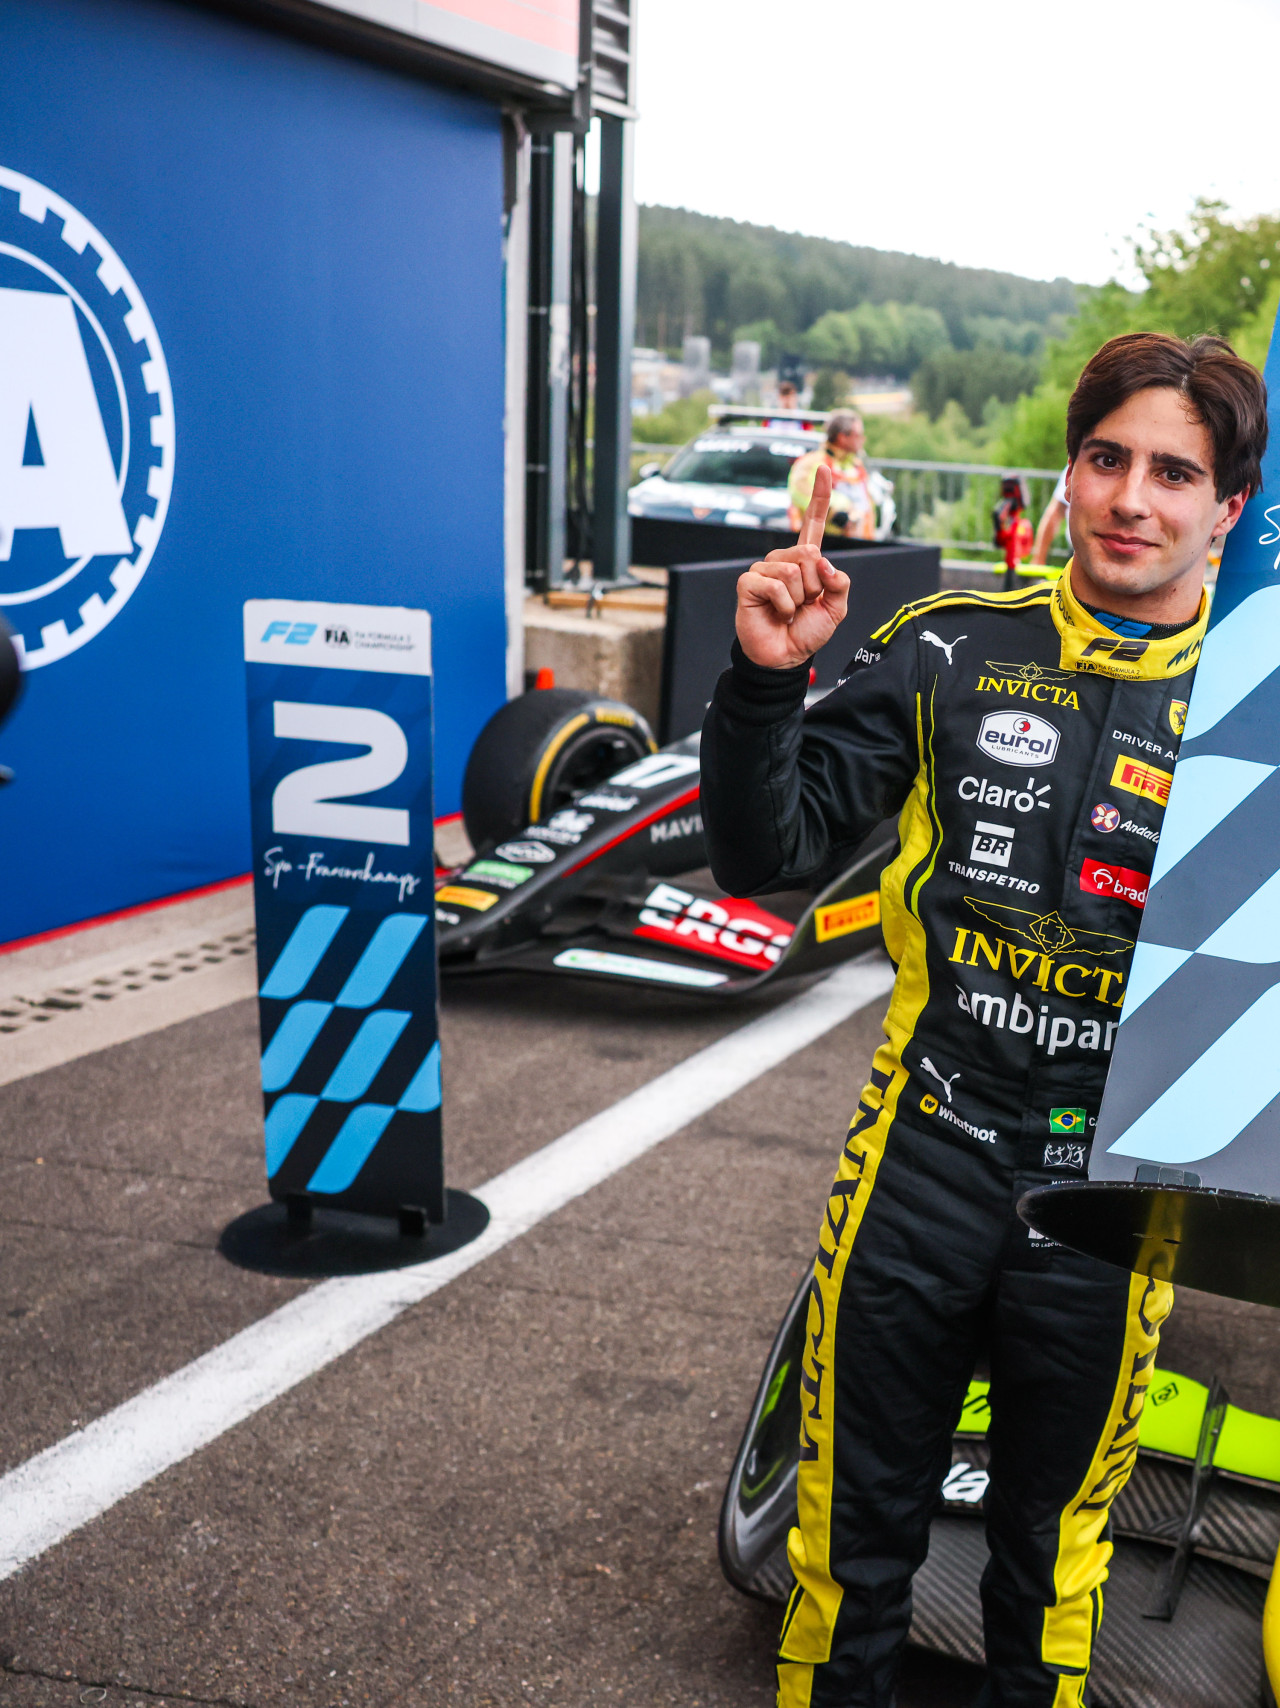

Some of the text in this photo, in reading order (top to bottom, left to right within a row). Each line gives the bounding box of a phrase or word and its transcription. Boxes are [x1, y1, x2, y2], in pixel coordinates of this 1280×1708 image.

[260, 620, 319, 646] F2
[1080, 637, 1150, 663] F2
[974, 675, 1080, 711] INVICTA
[984, 730, 1053, 755] eurol
[991, 744, 1040, 759] LUBRICANTS
[1112, 729, 1162, 755] DRIVER
[271, 700, 411, 847] 2
[1120, 763, 1173, 801] PIRE
[957, 776, 1051, 813] Claro
[1120, 819, 1160, 844] Andalu
[974, 837, 1009, 858] BR
[948, 860, 1041, 895] TRANSPETRO
[1113, 879, 1148, 904] brad
[938, 1104, 998, 1144] Whatnot
